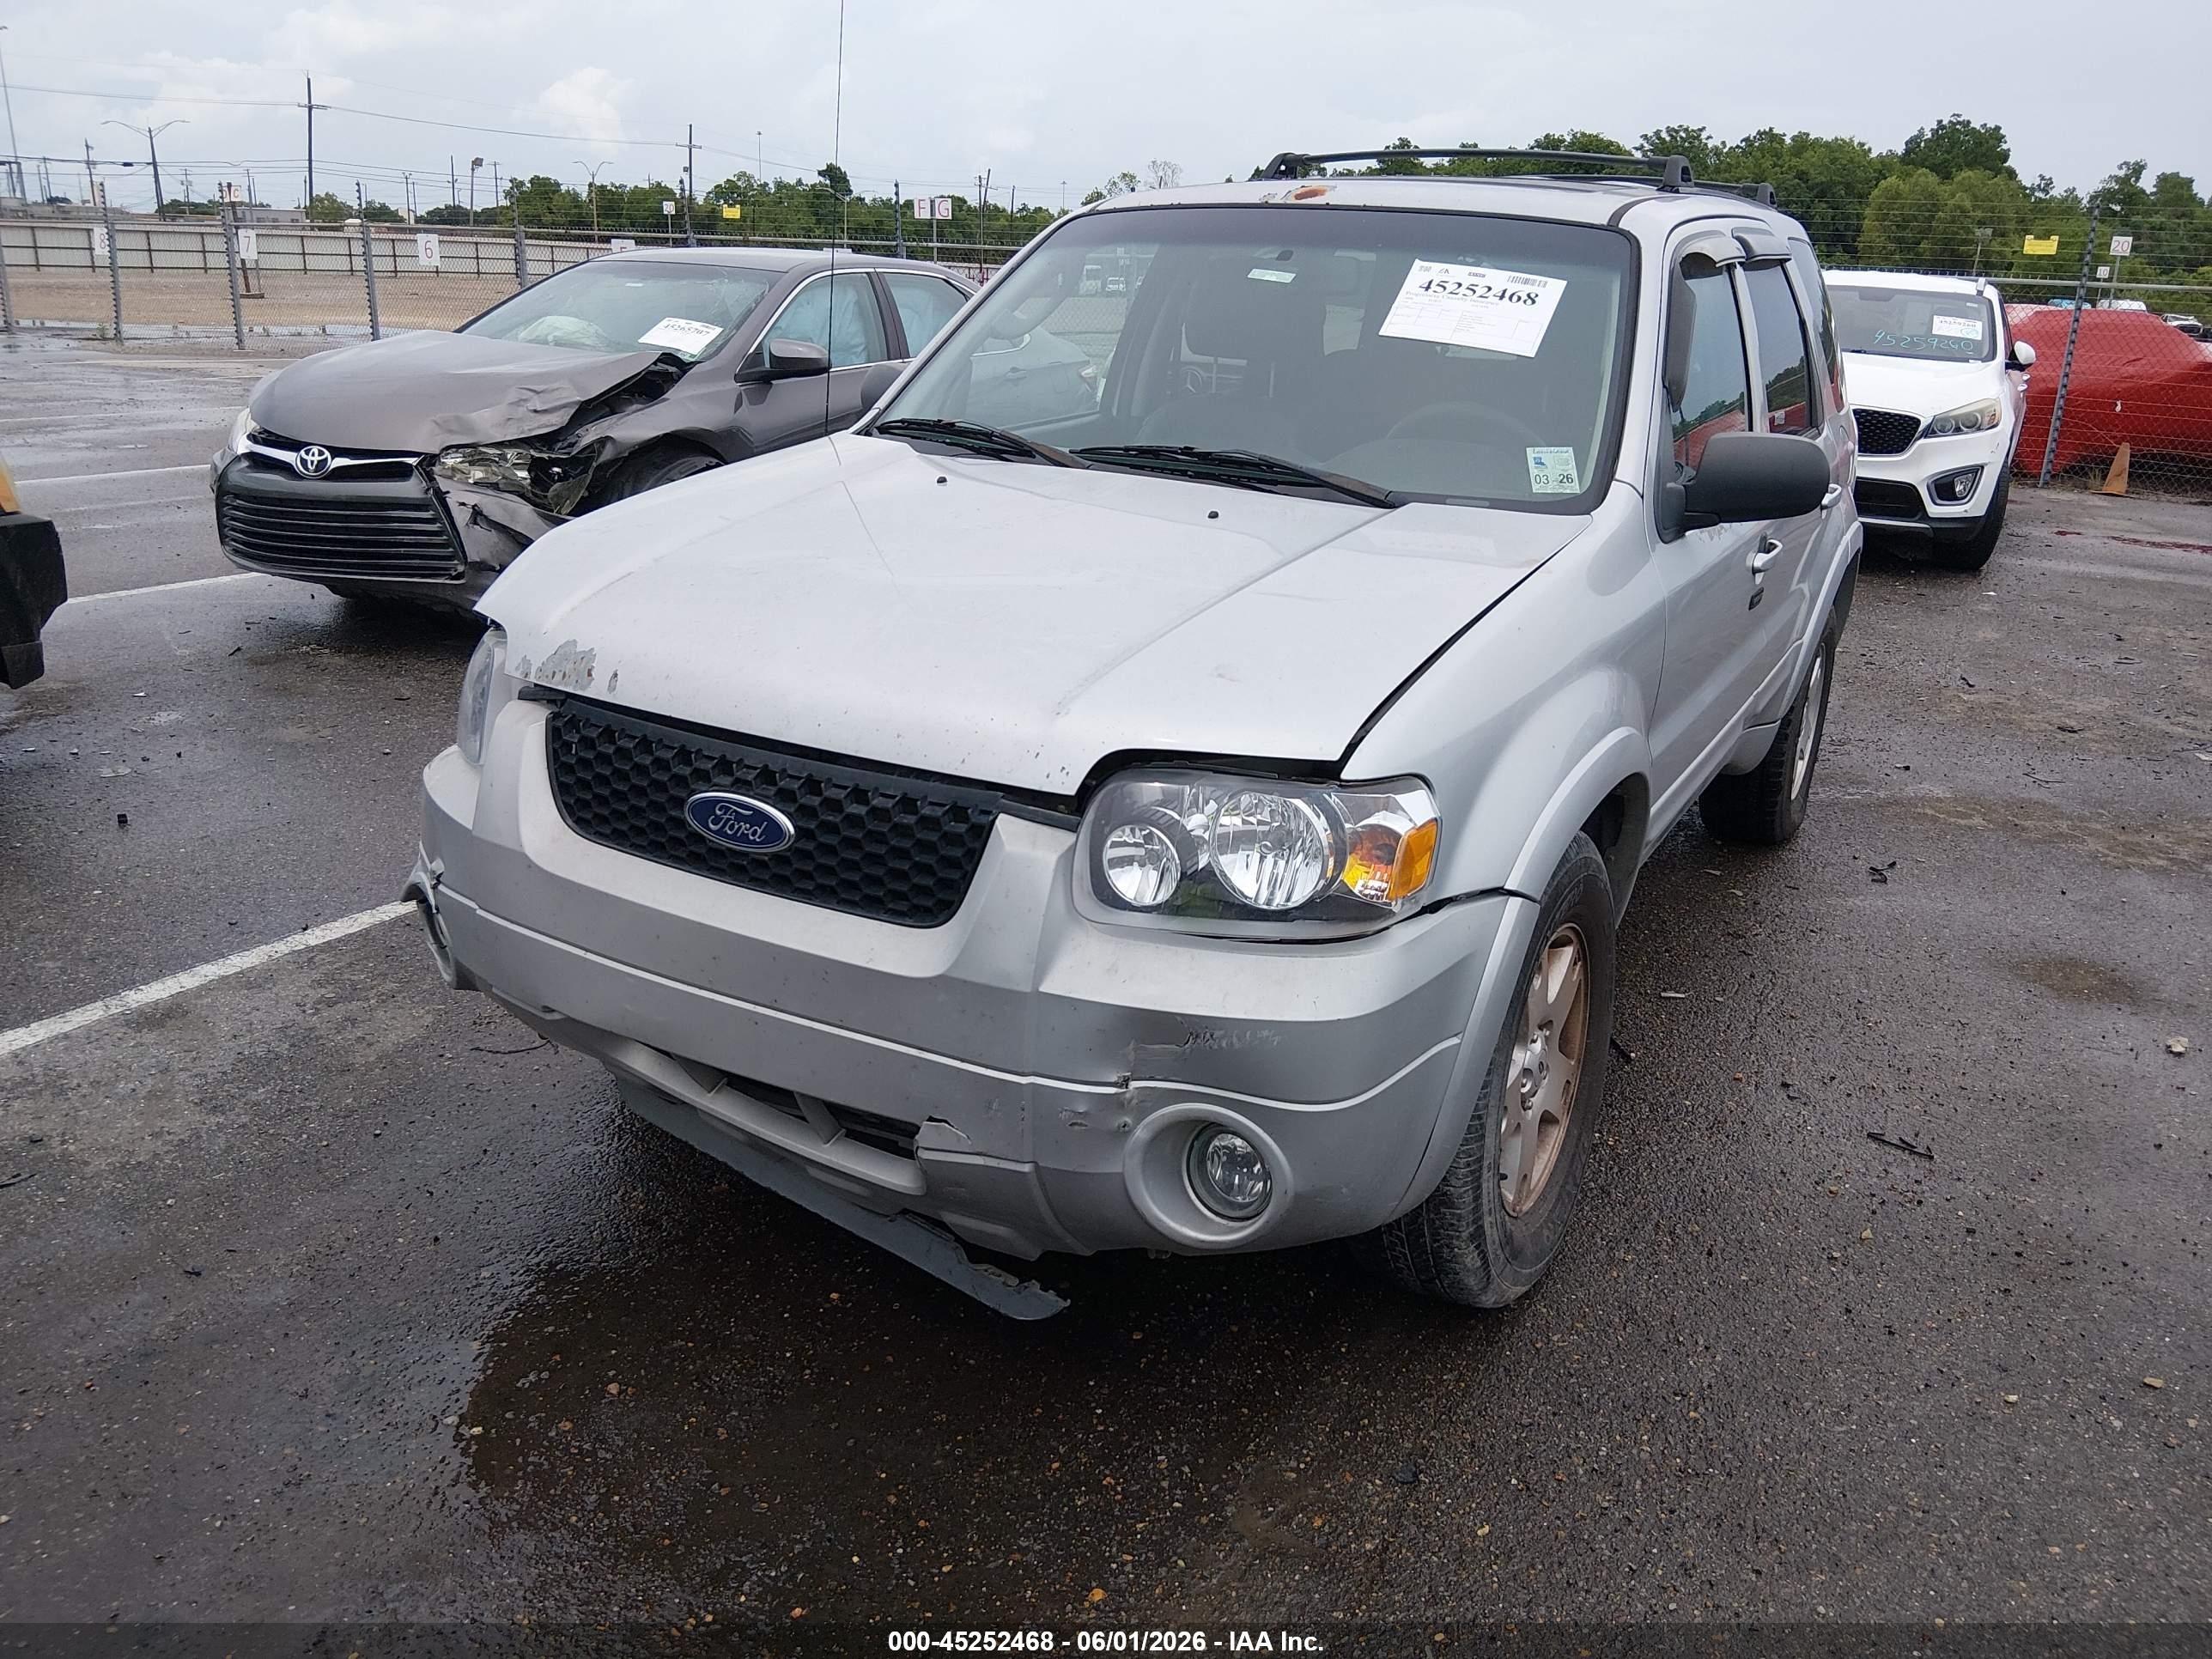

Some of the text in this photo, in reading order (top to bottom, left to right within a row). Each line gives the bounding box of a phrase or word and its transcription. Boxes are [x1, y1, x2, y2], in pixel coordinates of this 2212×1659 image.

[918, 198, 927, 218] F
[938, 199, 950, 218] G
[100, 233, 107, 249] 8
[243, 235, 251, 253] 7
[424, 240, 434, 260] 6
[2112, 240, 2130, 252] 20
[2099, 268, 2108, 276] 10
[1419, 278, 1539, 307] 45252468
[1534, 473, 1574, 485] 03 26
[708, 802, 768, 842] Ford
